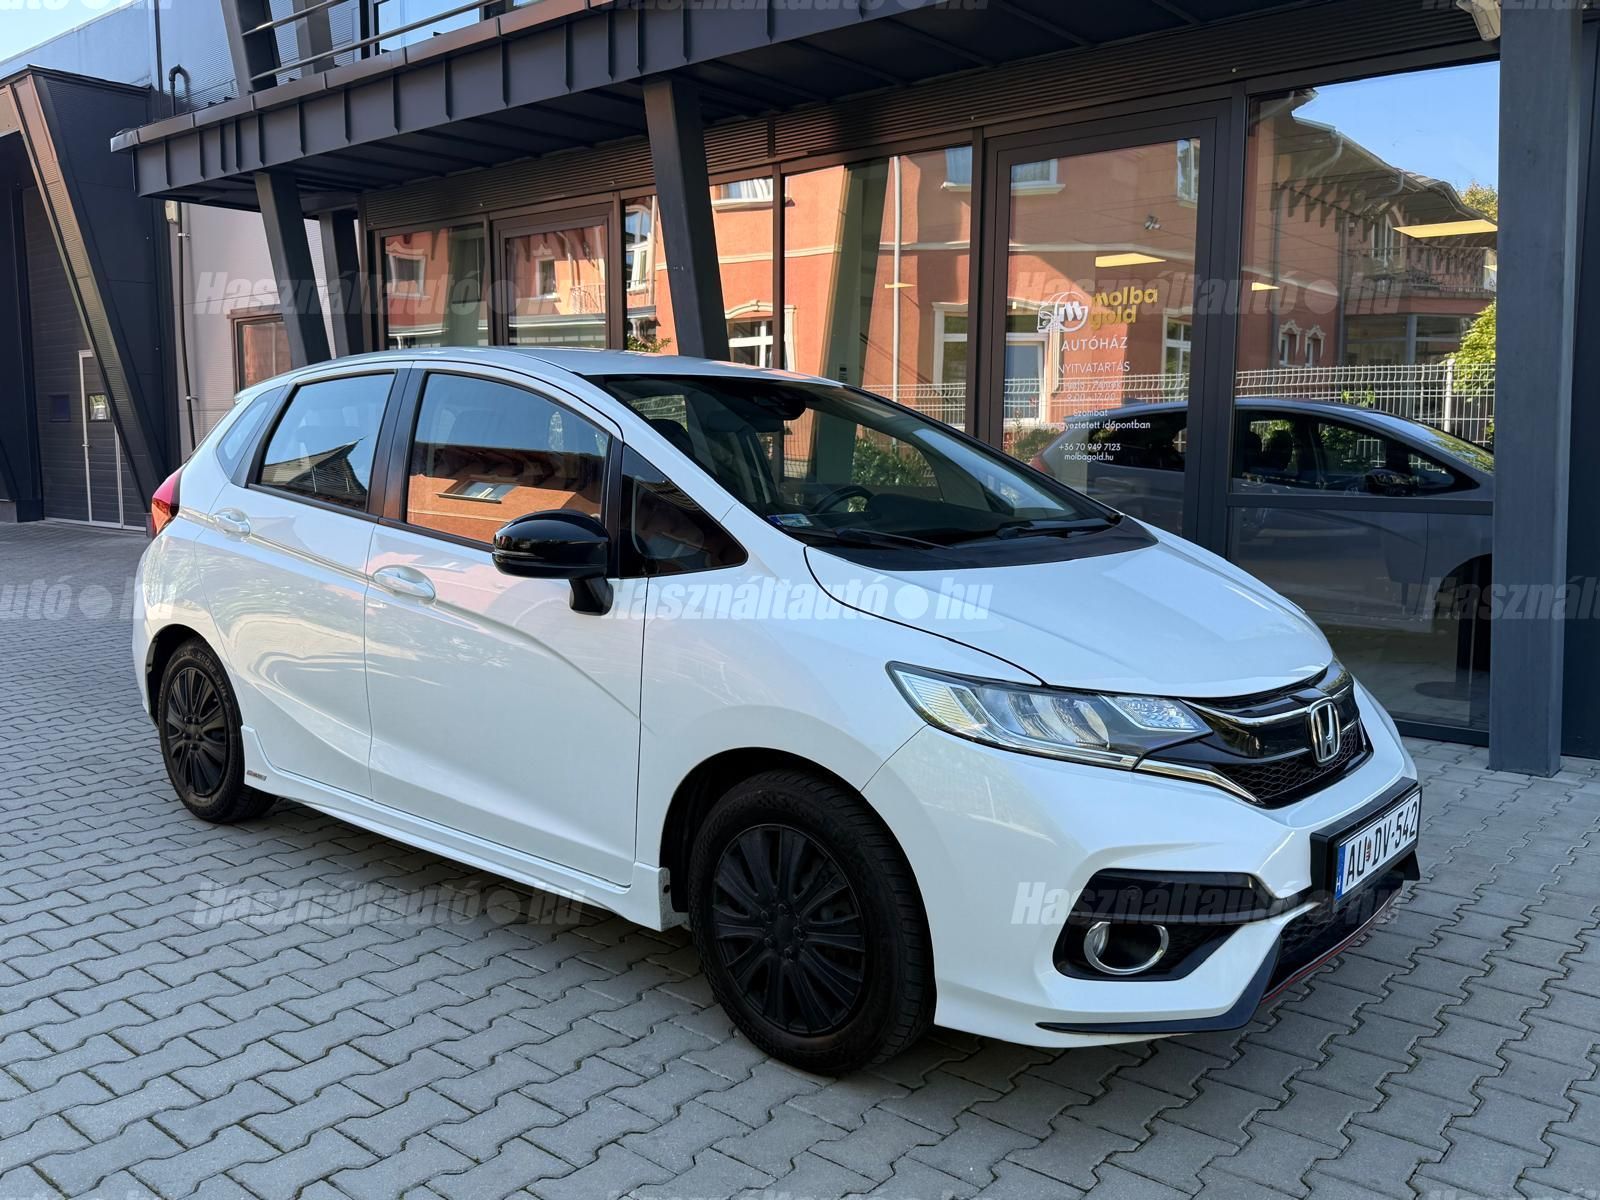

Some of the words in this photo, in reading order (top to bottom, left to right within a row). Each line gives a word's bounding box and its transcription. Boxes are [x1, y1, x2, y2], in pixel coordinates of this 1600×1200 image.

[1091, 286, 1159, 306] molba
[1089, 305, 1137, 331] gold
[1060, 334, 1128, 352] AUTÓHÁZ
[1058, 360, 1131, 375] NYITVATARTÁS
[1073, 408, 1108, 417] Szombat
[1102, 419, 1151, 431] időpontban
[1059, 443, 1074, 452] +36
[1075, 443, 1086, 452] 70
[1087, 443, 1102, 452] 949
[1103, 443, 1121, 452] 7123
[1064, 451, 1114, 462] molbagold.hu
[1346, 836, 1368, 886] AU
[1372, 801, 1418, 866] DV-542
